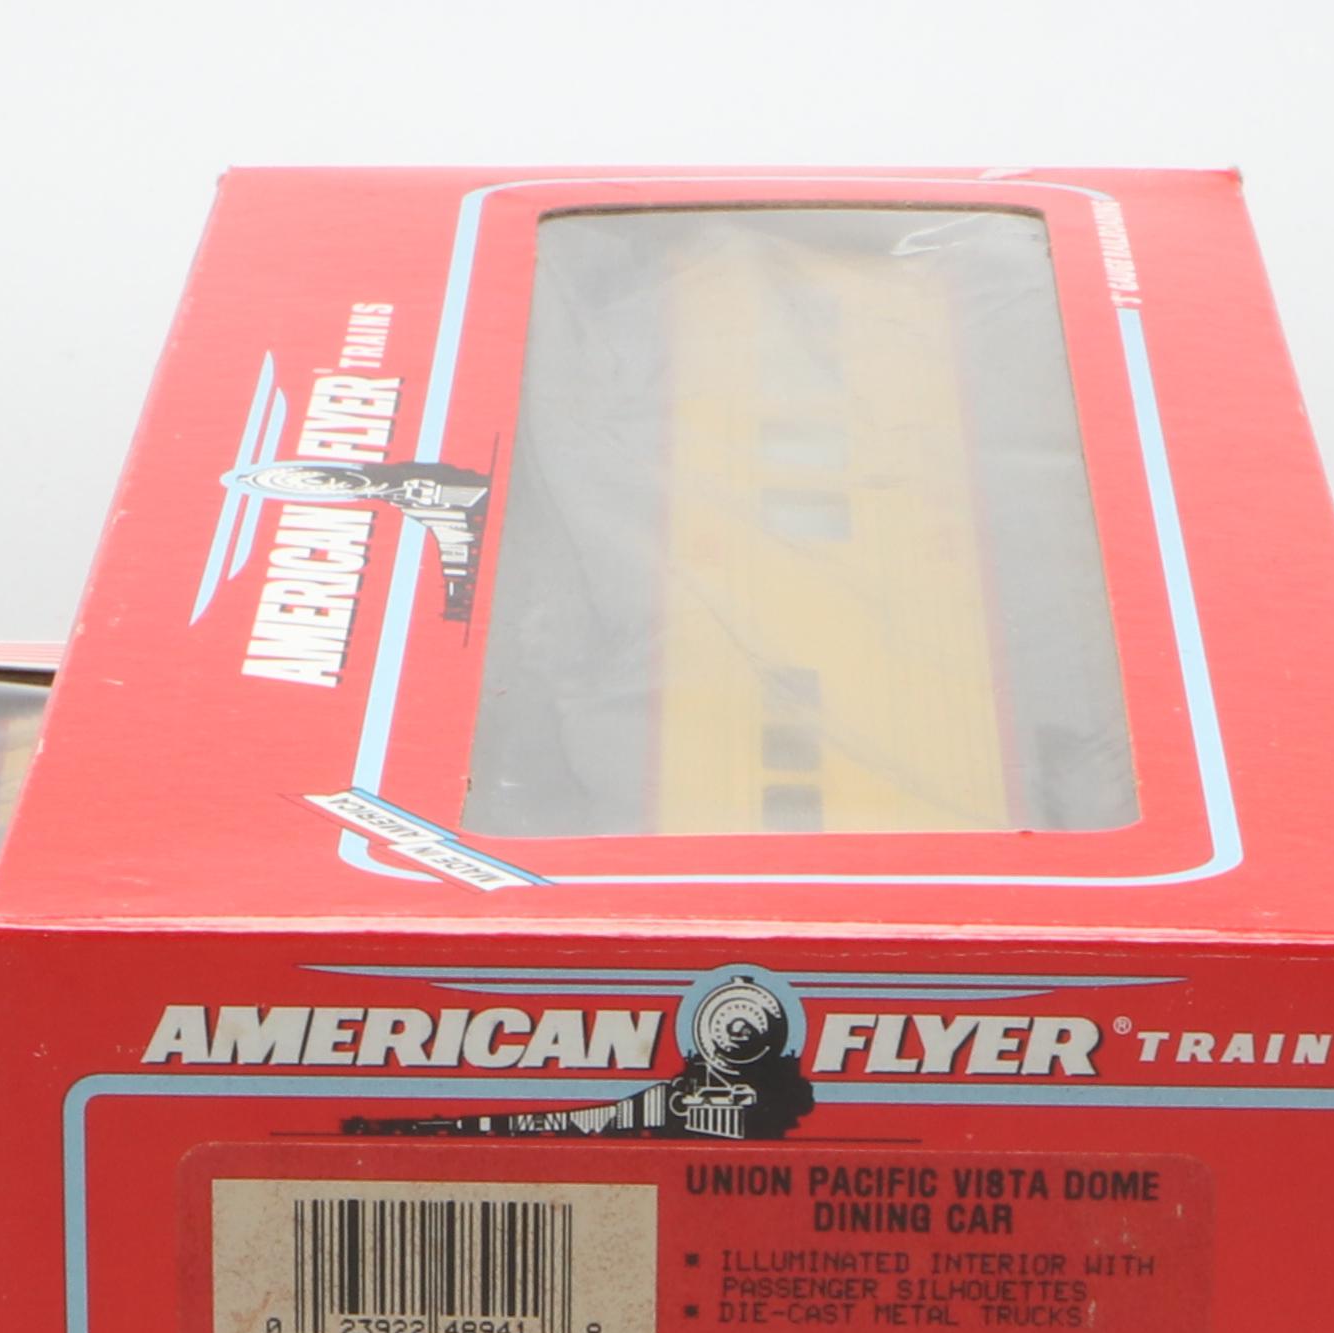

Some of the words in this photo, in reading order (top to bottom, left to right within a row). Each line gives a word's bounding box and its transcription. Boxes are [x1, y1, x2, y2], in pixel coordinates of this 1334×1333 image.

[338, 302, 395, 368] TRAINS
[297, 375, 406, 463] FLYER
[241, 504, 378, 689] AMERICAN
[328, 797, 429, 839] AMERICA
[141, 1005, 667, 1070] AMERICAN
[811, 1013, 1103, 1077] FLYER
[687, 1166, 793, 1197] UNION
[810, 1167, 938, 1199] PACIFIC
[955, 1170, 1049, 1200] VISTA
[1065, 1171, 1159, 1202] DOME
[815, 1202, 932, 1234] DINING
[948, 1204, 1013, 1234] CAR
[723, 1250, 911, 1276] ILLUMINATED
[933, 1253, 1068, 1279] INTERIOR
[1085, 1255, 1155, 1277] WITH
[723, 1277, 879, 1302] PASSENGER
[898, 1280, 1087, 1305] SILHOUETTES
[720, 1300, 857, 1325] DIE-CAST
[875, 1301, 959, 1327] METAL
[981, 1303, 1083, 1329] TRUCKS
